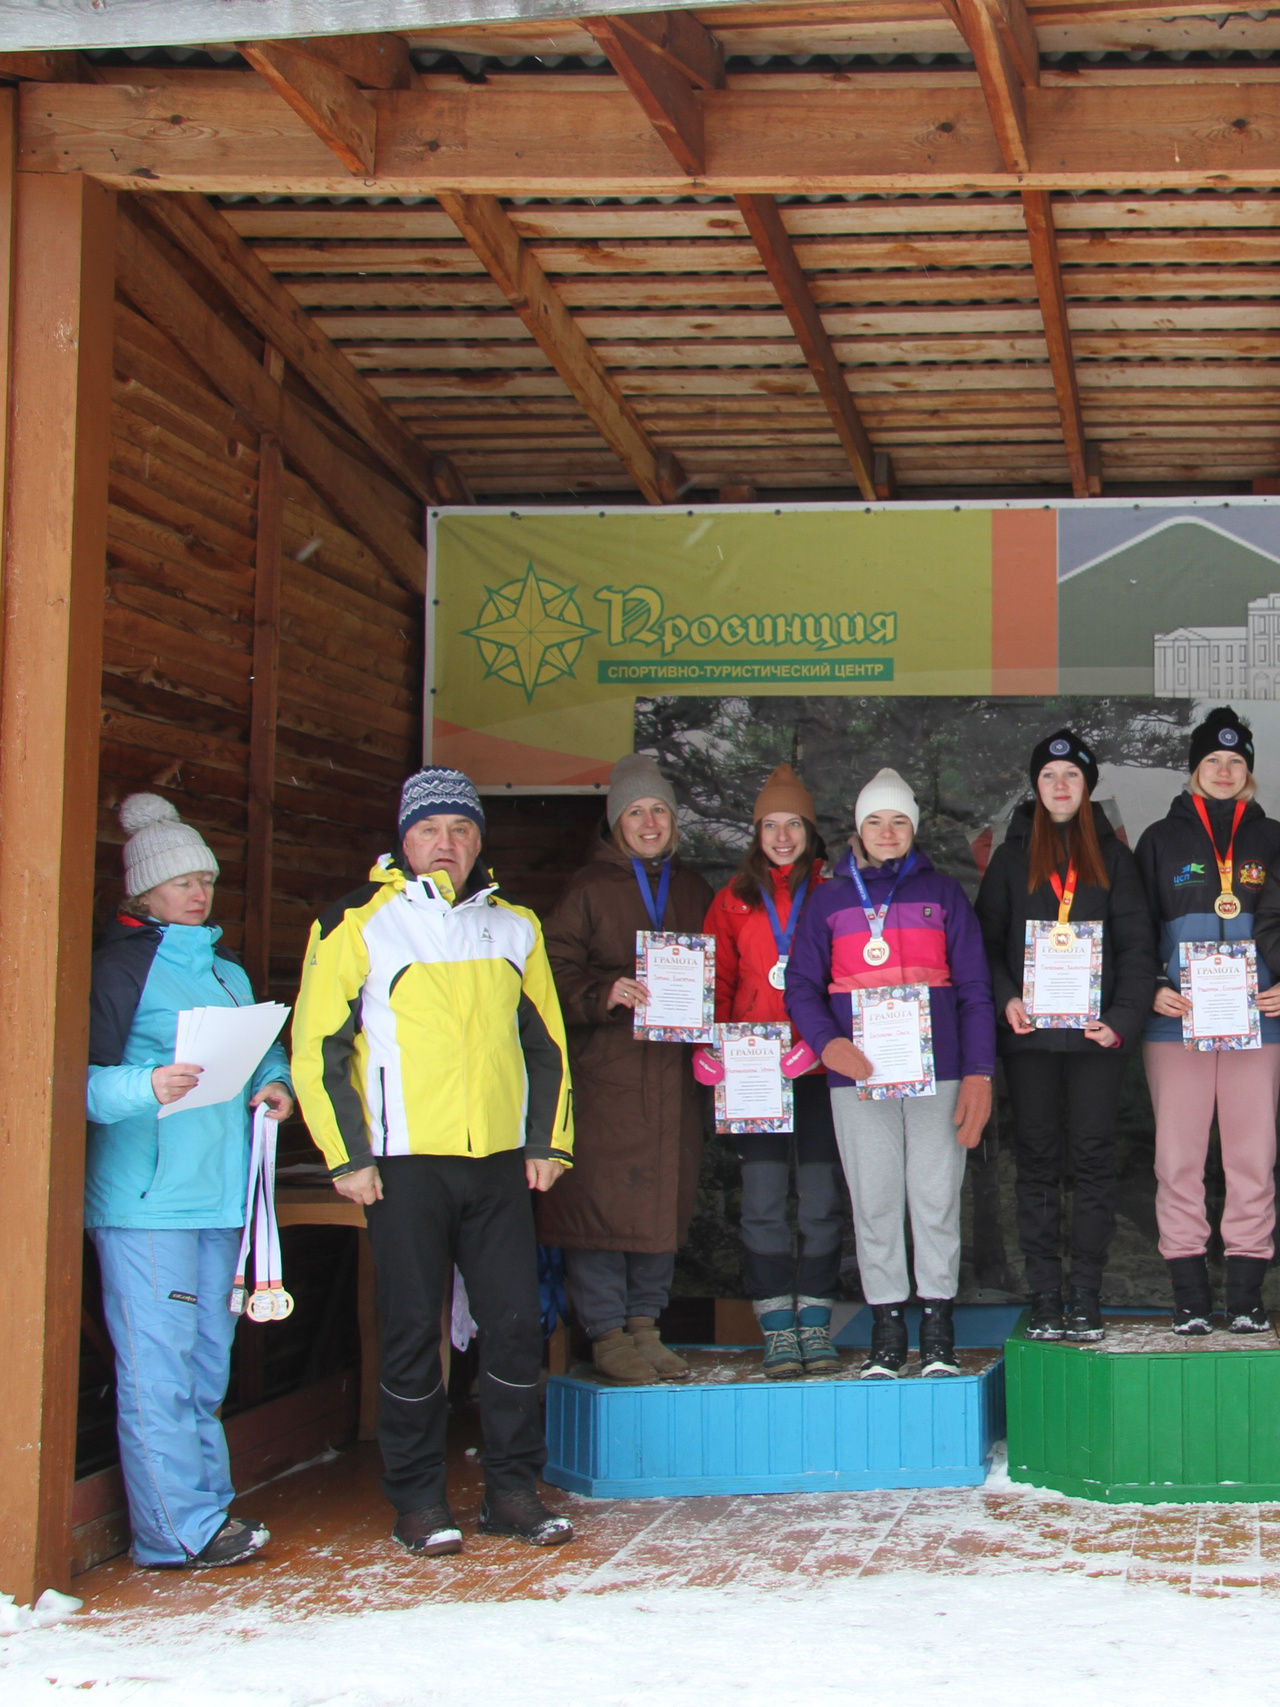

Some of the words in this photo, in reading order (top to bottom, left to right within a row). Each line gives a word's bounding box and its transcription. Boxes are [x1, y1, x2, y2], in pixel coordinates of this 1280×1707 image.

[593, 584, 898, 657] Провинция
[607, 662, 831, 679] СПОРТИВНО-ТУРИСТИЧЕСКИЙ
[834, 663, 884, 678] ЦЕНТР
[653, 956, 698, 966] ГРАМОТА
[1196, 966, 1241, 975] ГРАМОТА
[869, 1010, 913, 1021] ГРАМОТА
[729, 1047, 774, 1057] ГРАМОТА
